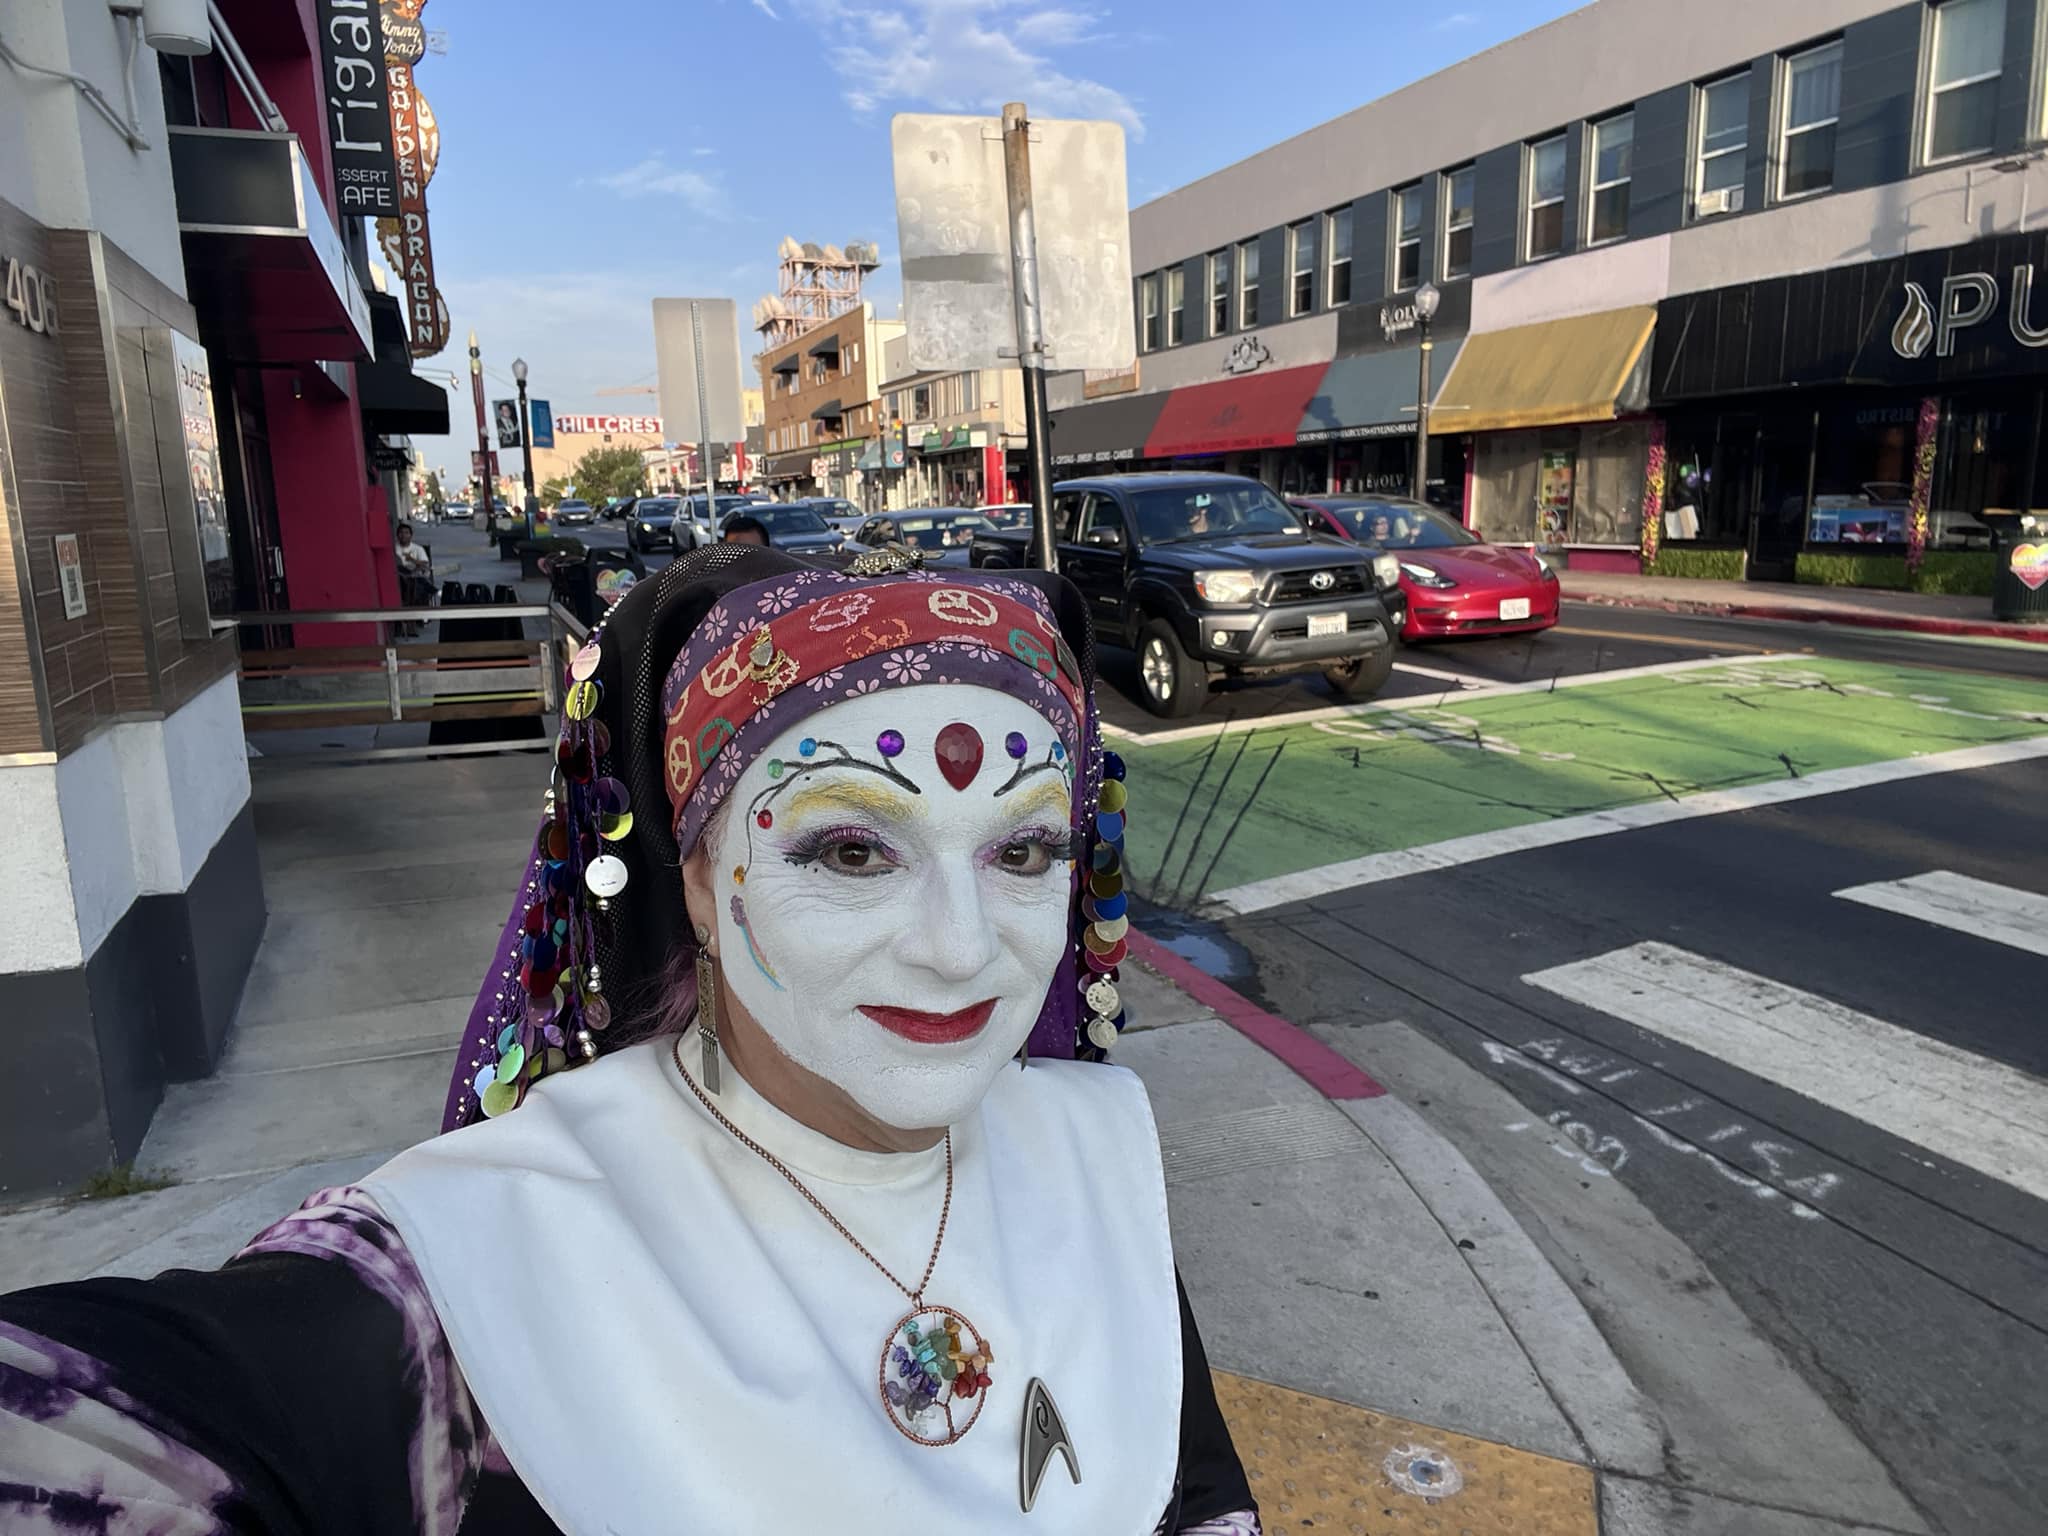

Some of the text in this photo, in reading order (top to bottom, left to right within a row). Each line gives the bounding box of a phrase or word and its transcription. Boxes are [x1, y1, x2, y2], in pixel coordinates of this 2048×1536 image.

[341, 185, 392, 206] AFE
[388, 66, 434, 343] GOLDEN DRAGON
[562, 416, 664, 433] HILLCREST
